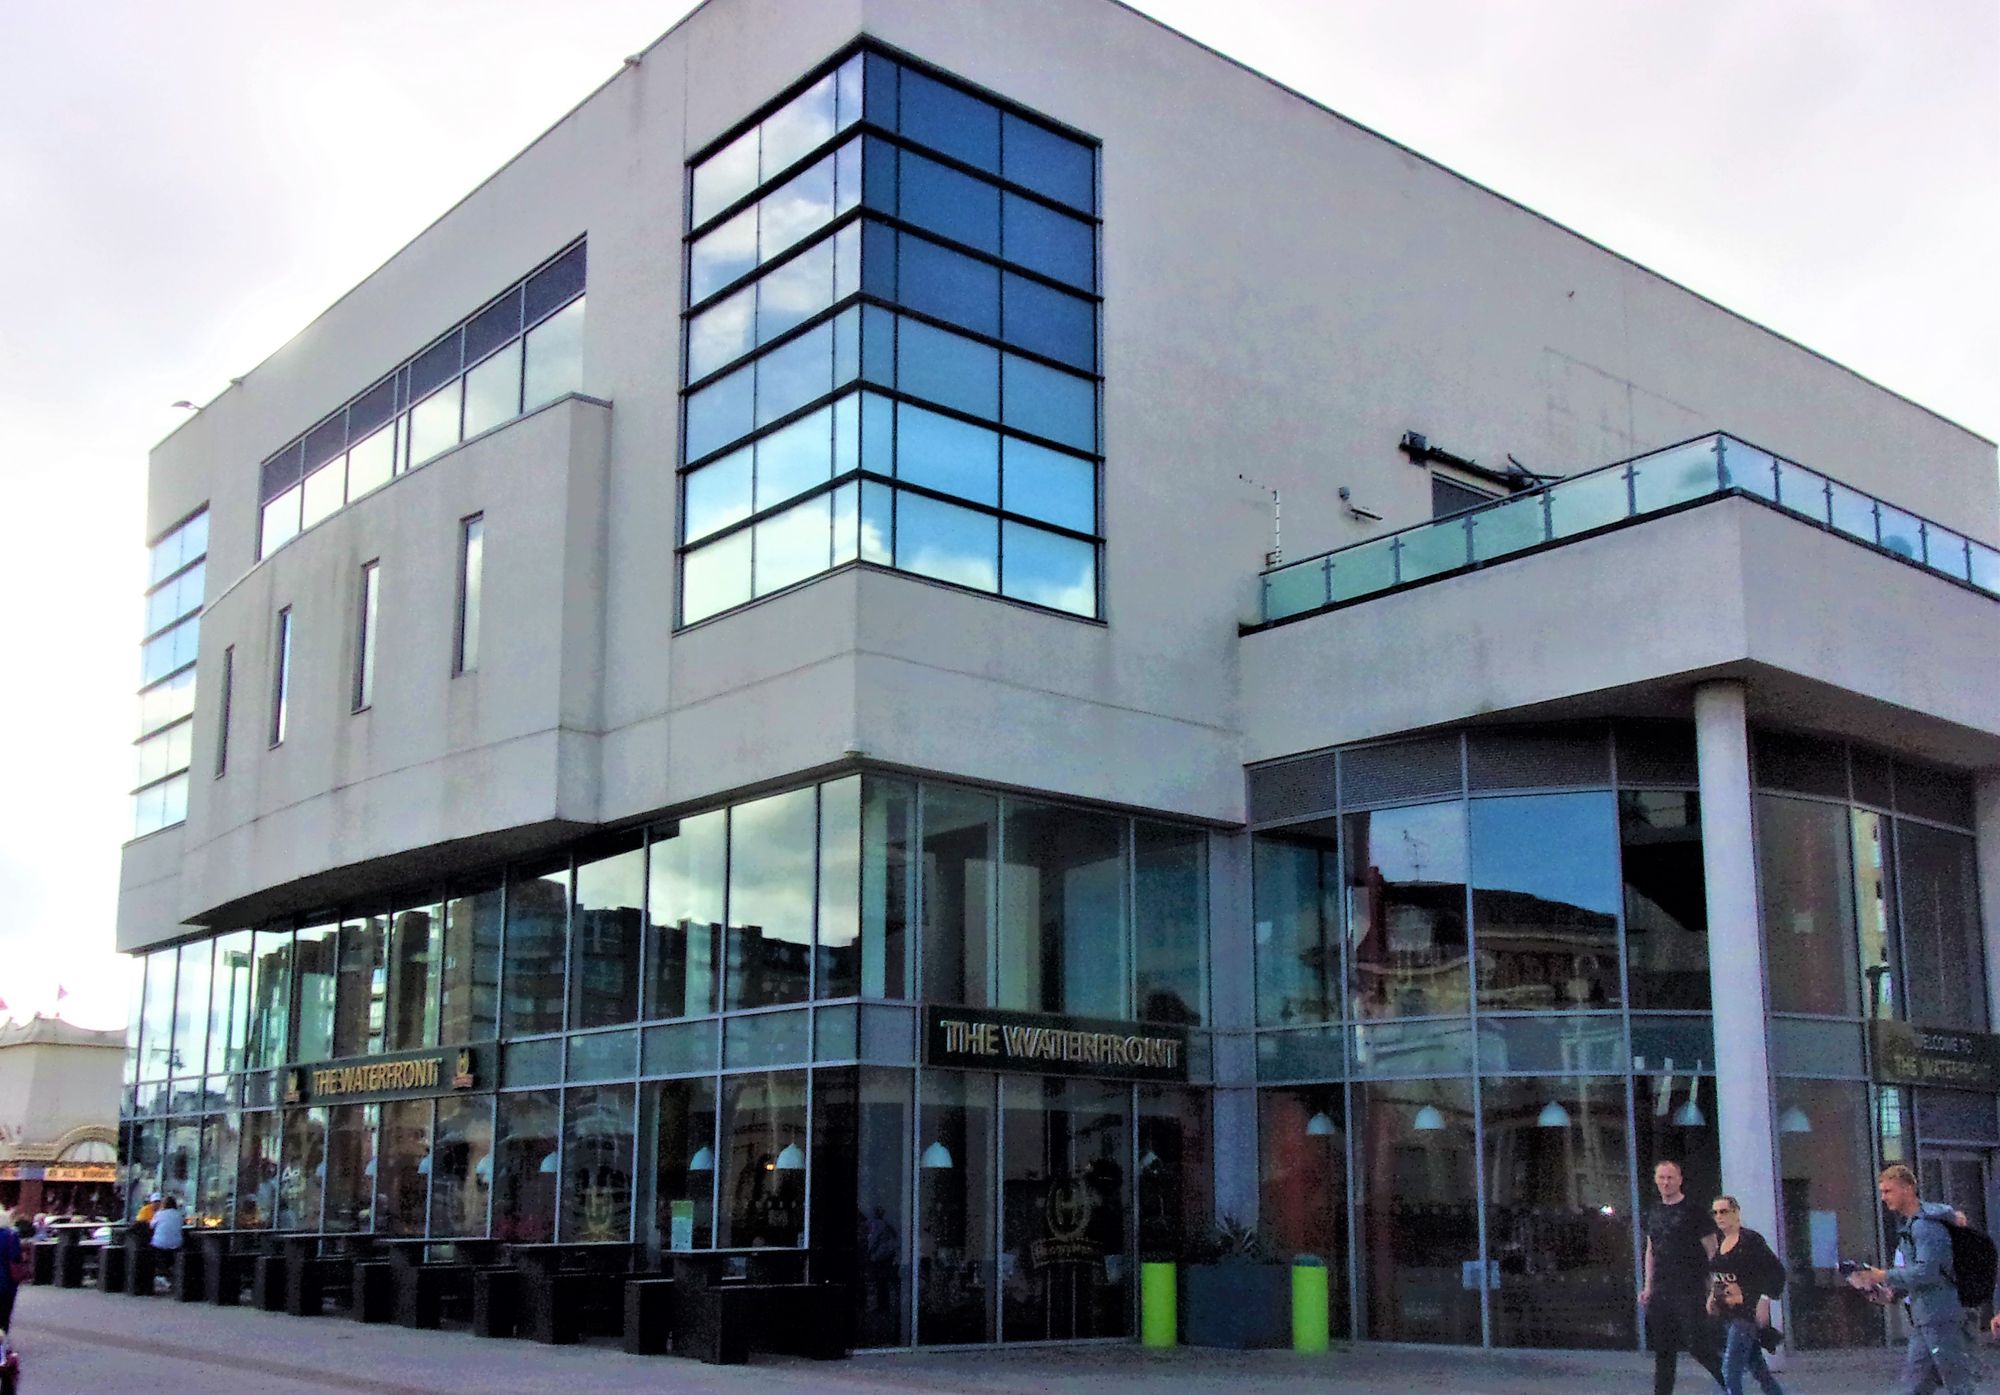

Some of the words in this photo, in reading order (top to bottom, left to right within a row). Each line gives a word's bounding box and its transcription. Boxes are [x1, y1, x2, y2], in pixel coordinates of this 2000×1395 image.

[940, 1020, 999, 1055] THE
[1002, 1025, 1182, 1068] WATERFRONT
[313, 1069, 338, 1096] THE
[339, 1058, 442, 1093] WATERFRONT
